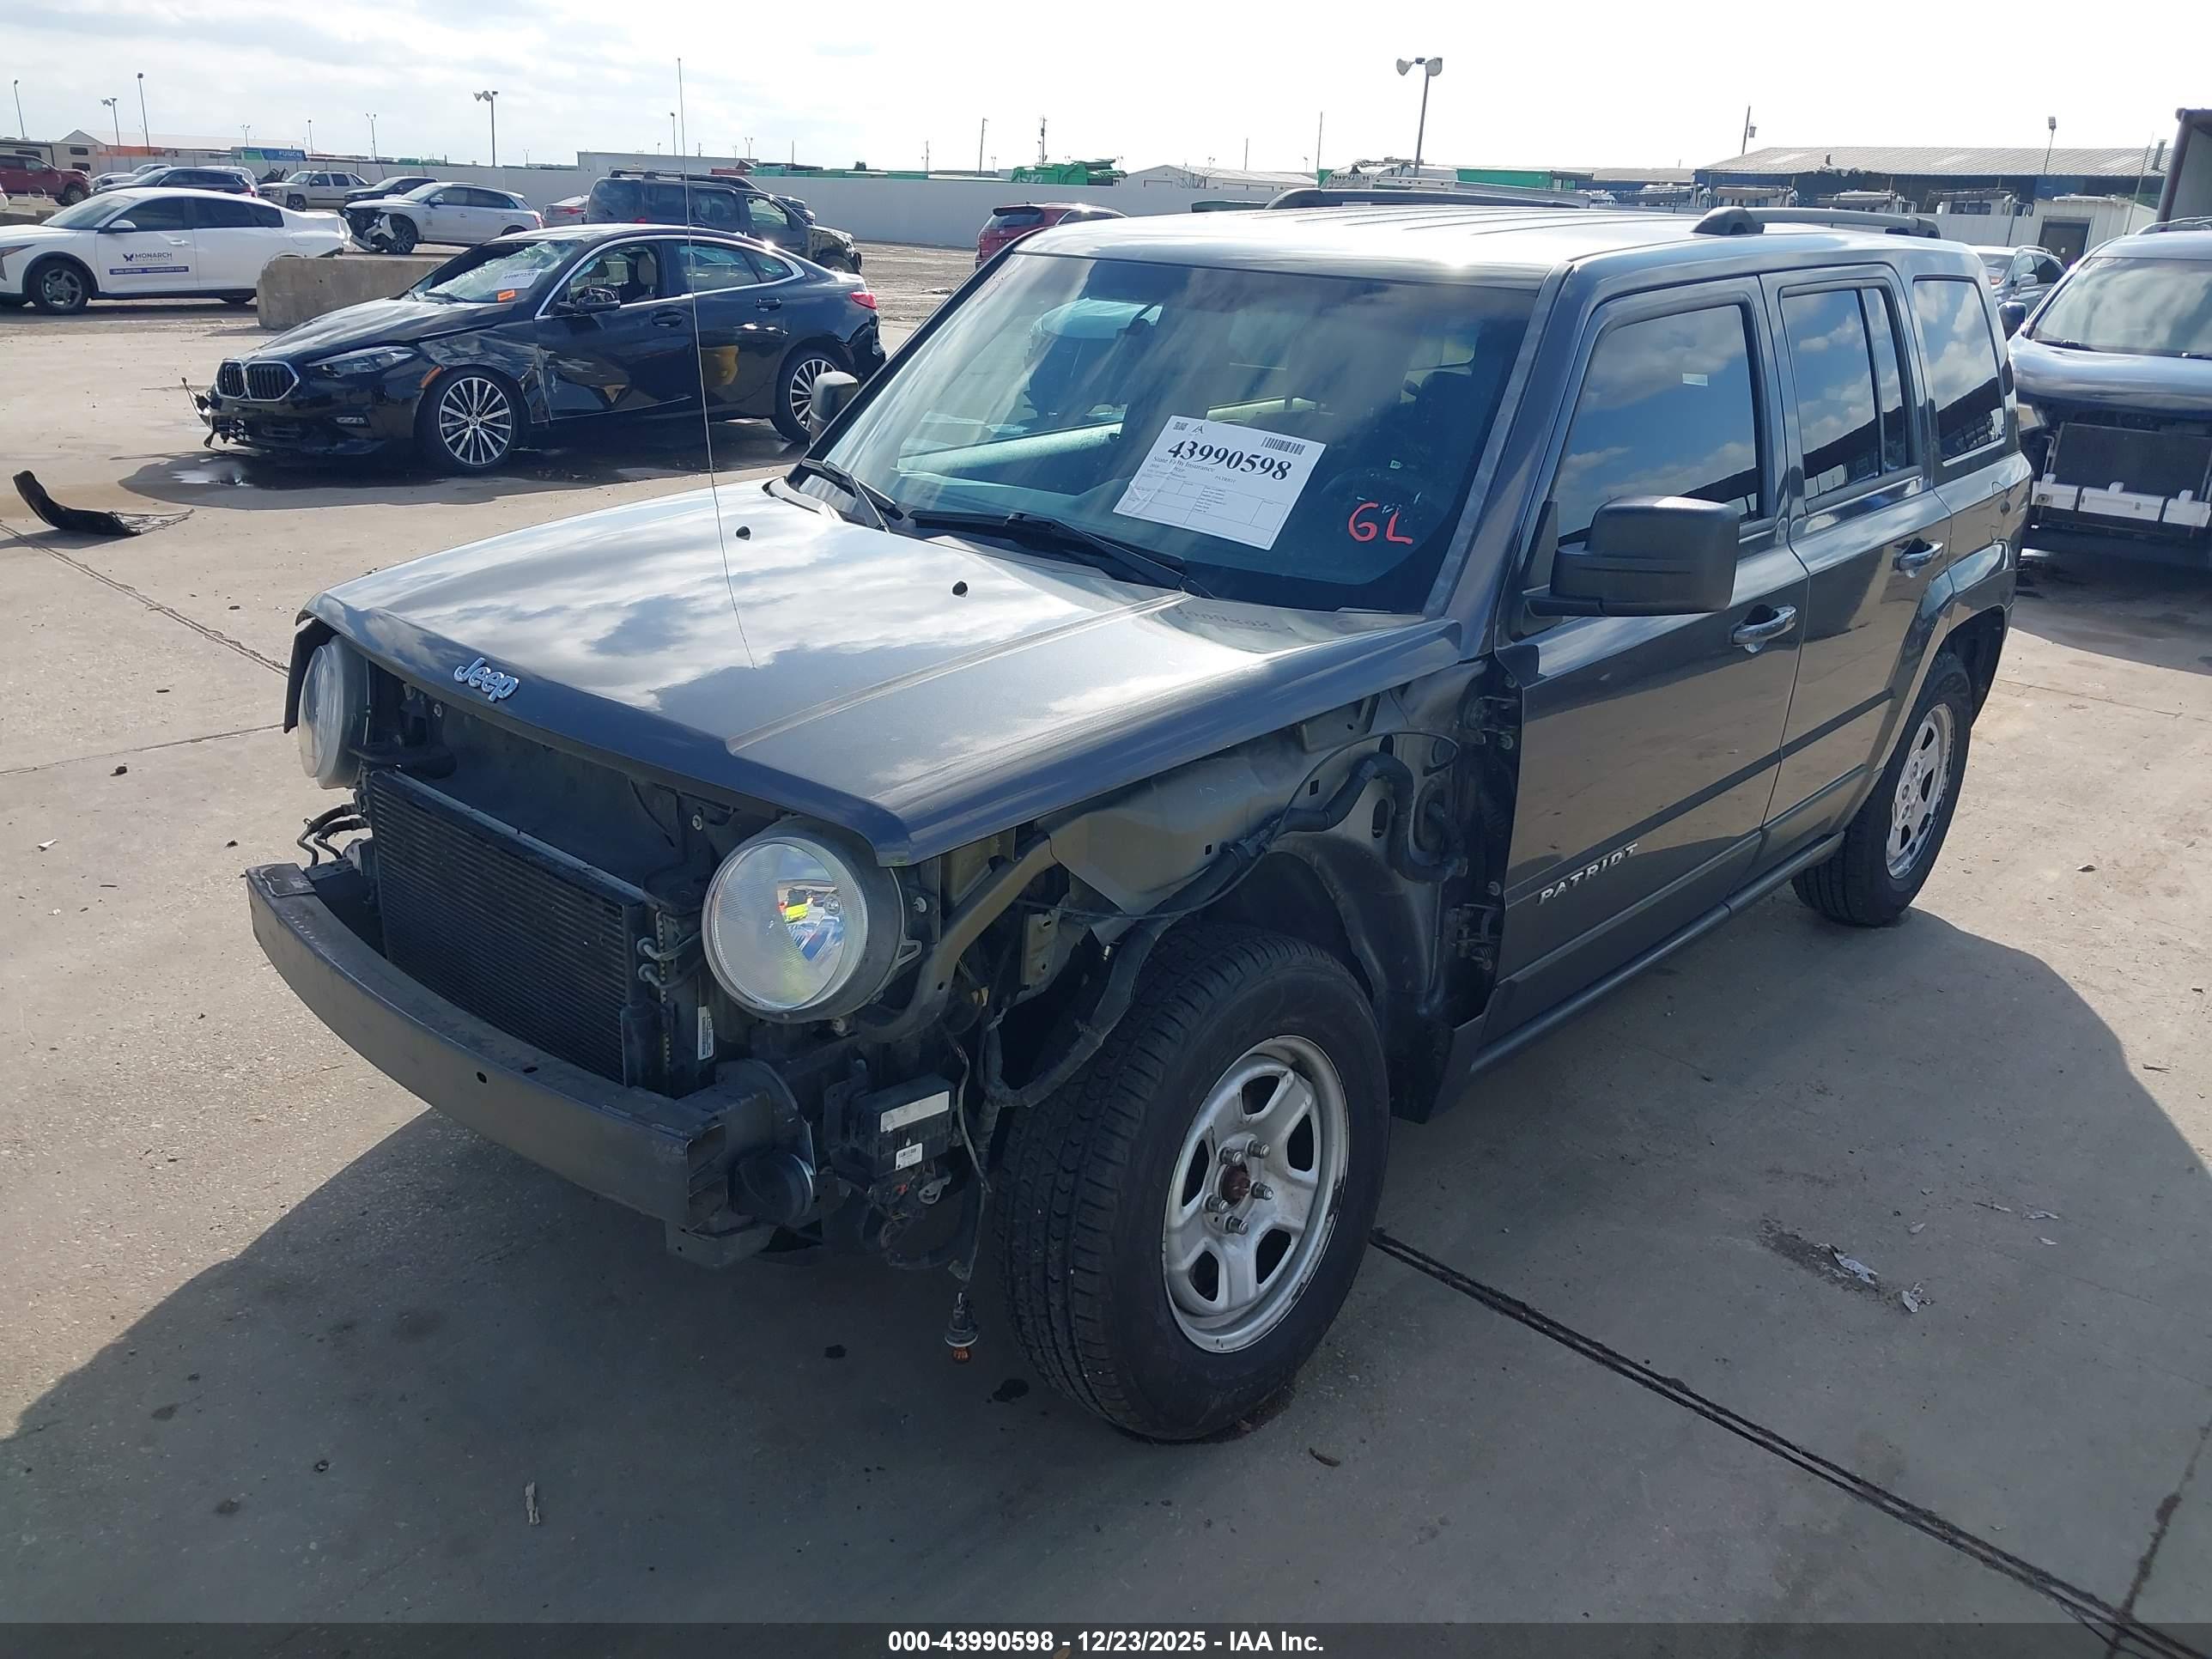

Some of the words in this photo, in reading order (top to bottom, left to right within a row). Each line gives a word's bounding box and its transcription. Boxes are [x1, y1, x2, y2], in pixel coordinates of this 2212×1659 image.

[1153, 455, 1169, 465] State
[1186, 460, 1216, 473] Insurance
[1167, 440, 1292, 481] 43990598
[453, 657, 520, 702] Jeep
[1537, 842, 1638, 906] PATRIOT
